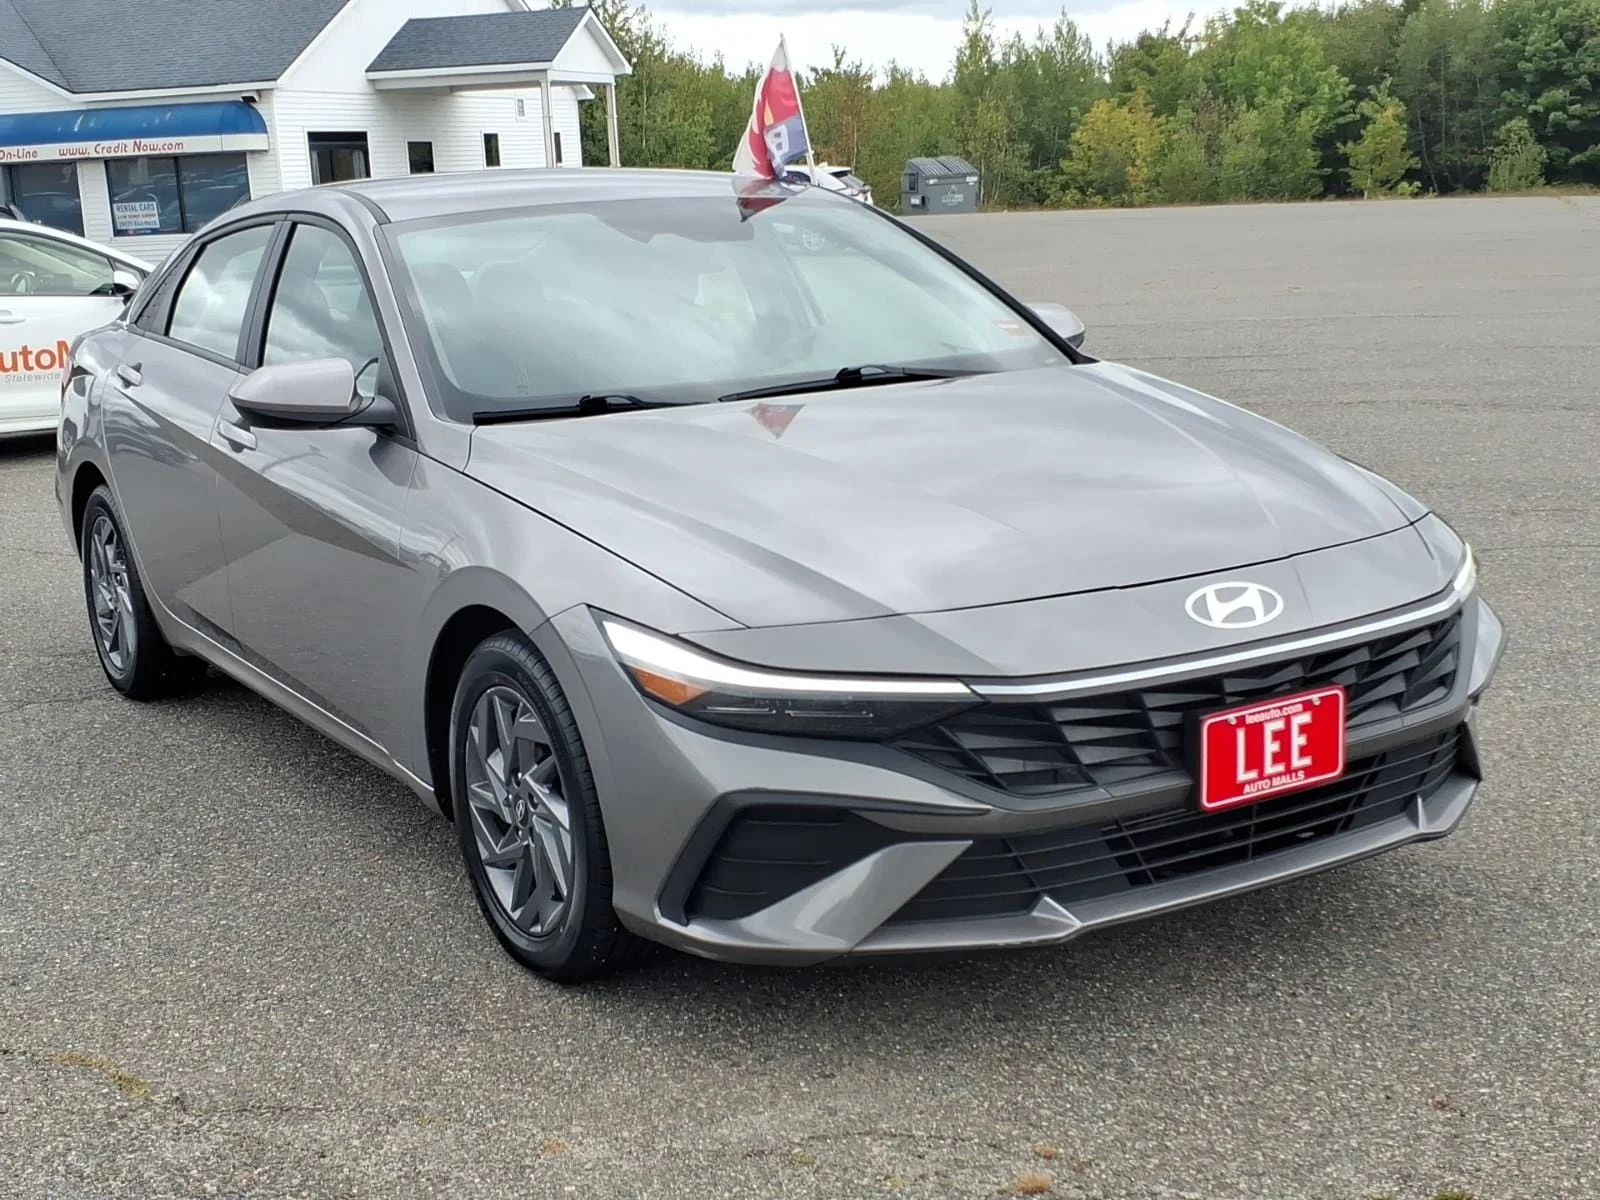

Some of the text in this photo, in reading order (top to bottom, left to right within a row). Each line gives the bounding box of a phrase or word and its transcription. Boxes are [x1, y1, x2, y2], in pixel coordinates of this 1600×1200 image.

[0, 148, 38, 160] On-Line
[94, 142, 128, 154] Credit
[116, 203, 138, 212] RENTAL
[4, 372, 61, 383] Statewide
[1236, 711, 1313, 785] LEE
[1243, 770, 1305, 795] AUTO MALLS
